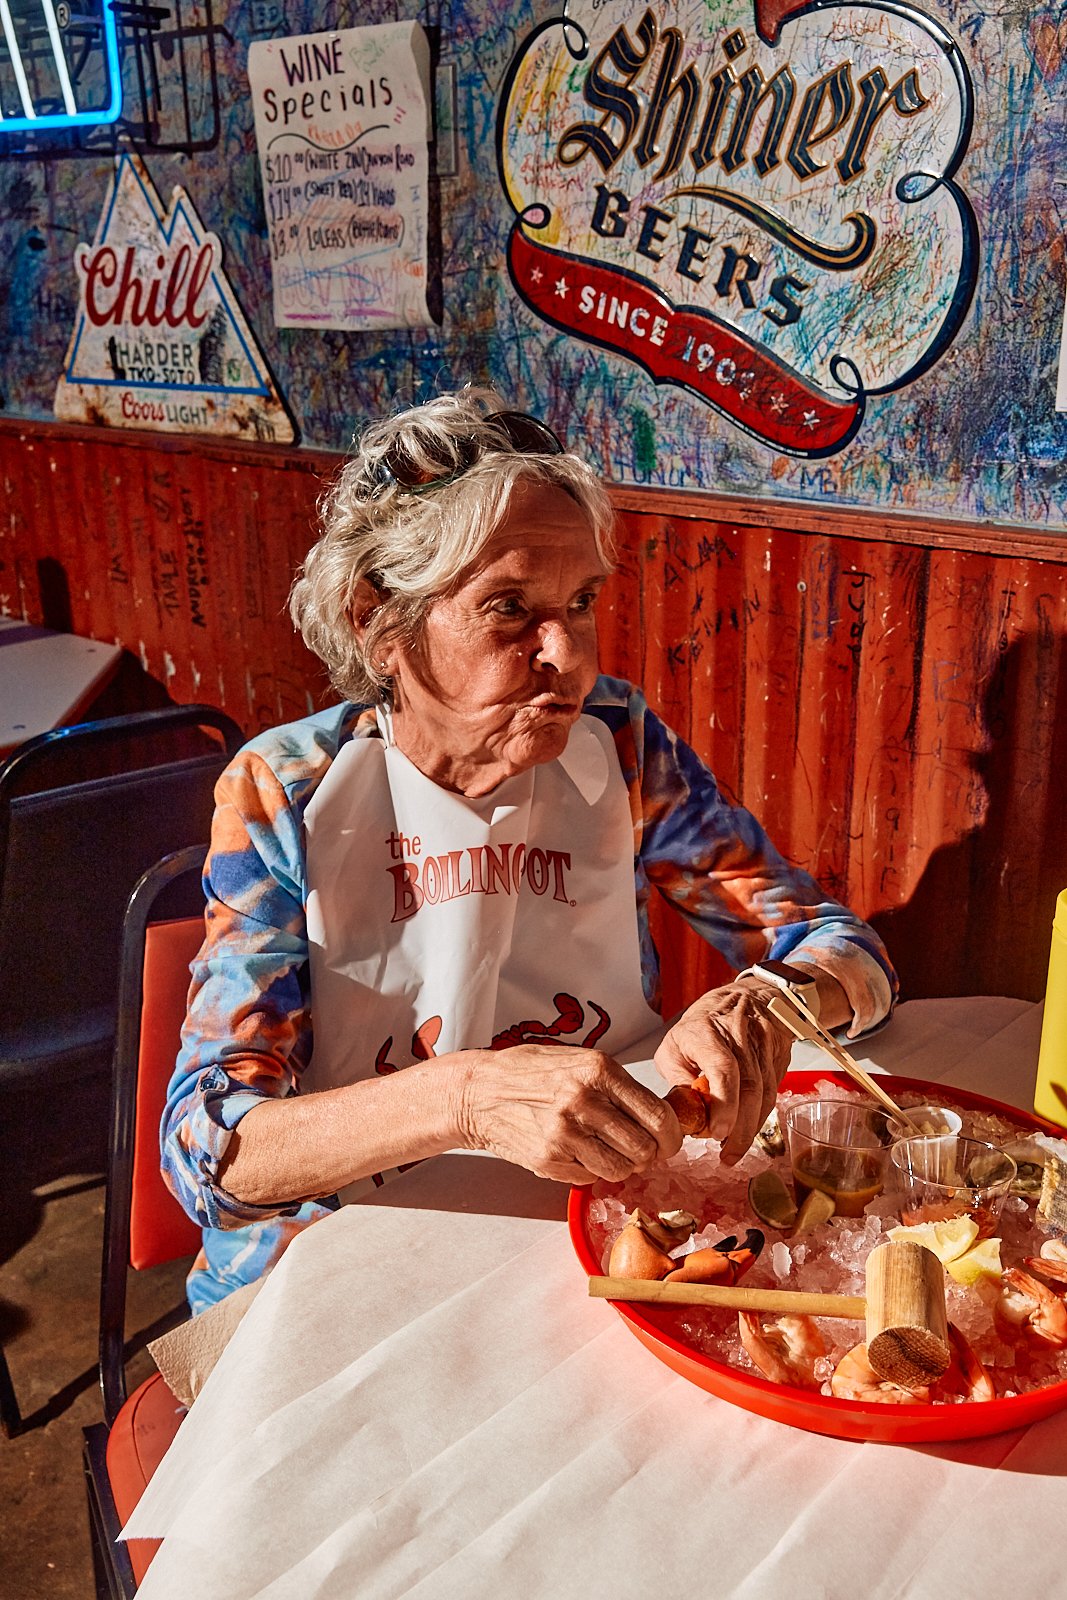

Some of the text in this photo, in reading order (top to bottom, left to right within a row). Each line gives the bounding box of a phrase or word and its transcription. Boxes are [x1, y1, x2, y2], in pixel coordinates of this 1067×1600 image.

[280, 38, 345, 87] WINE
[263, 77, 393, 124] Specials
[557, 8, 930, 184] Shiner
[590, 183, 813, 327] BEERS
[81, 243, 215, 328] Chill
[578, 285, 669, 347] SINCE
[118, 343, 194, 368] HARDER
[120, 391, 208, 426] Coors LIGHT
[385, 831, 421, 859] the
